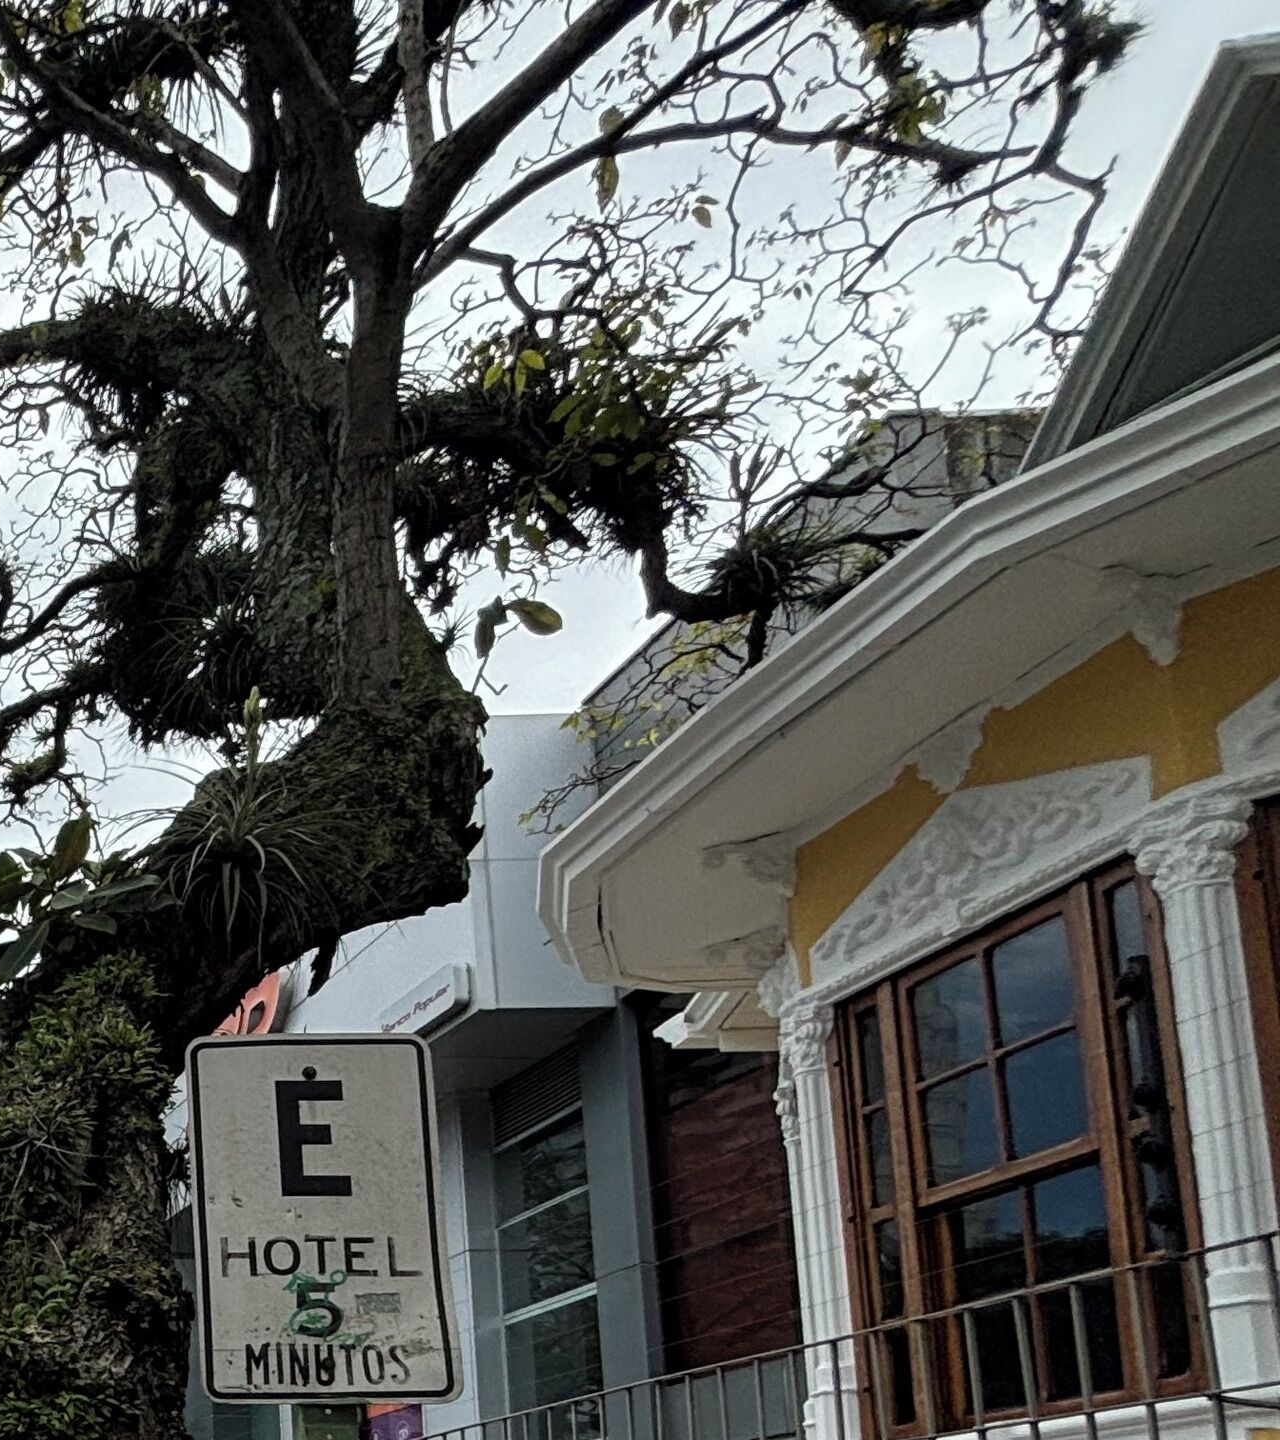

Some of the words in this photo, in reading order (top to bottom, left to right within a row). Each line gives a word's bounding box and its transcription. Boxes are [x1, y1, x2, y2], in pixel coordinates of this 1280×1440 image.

[412, 983, 450, 1015] Popular
[275, 1080, 352, 1197] E
[220, 1234, 423, 1277] HOTEL
[295, 1281, 344, 1337] 5
[245, 1342, 411, 1386] MINUTOS
